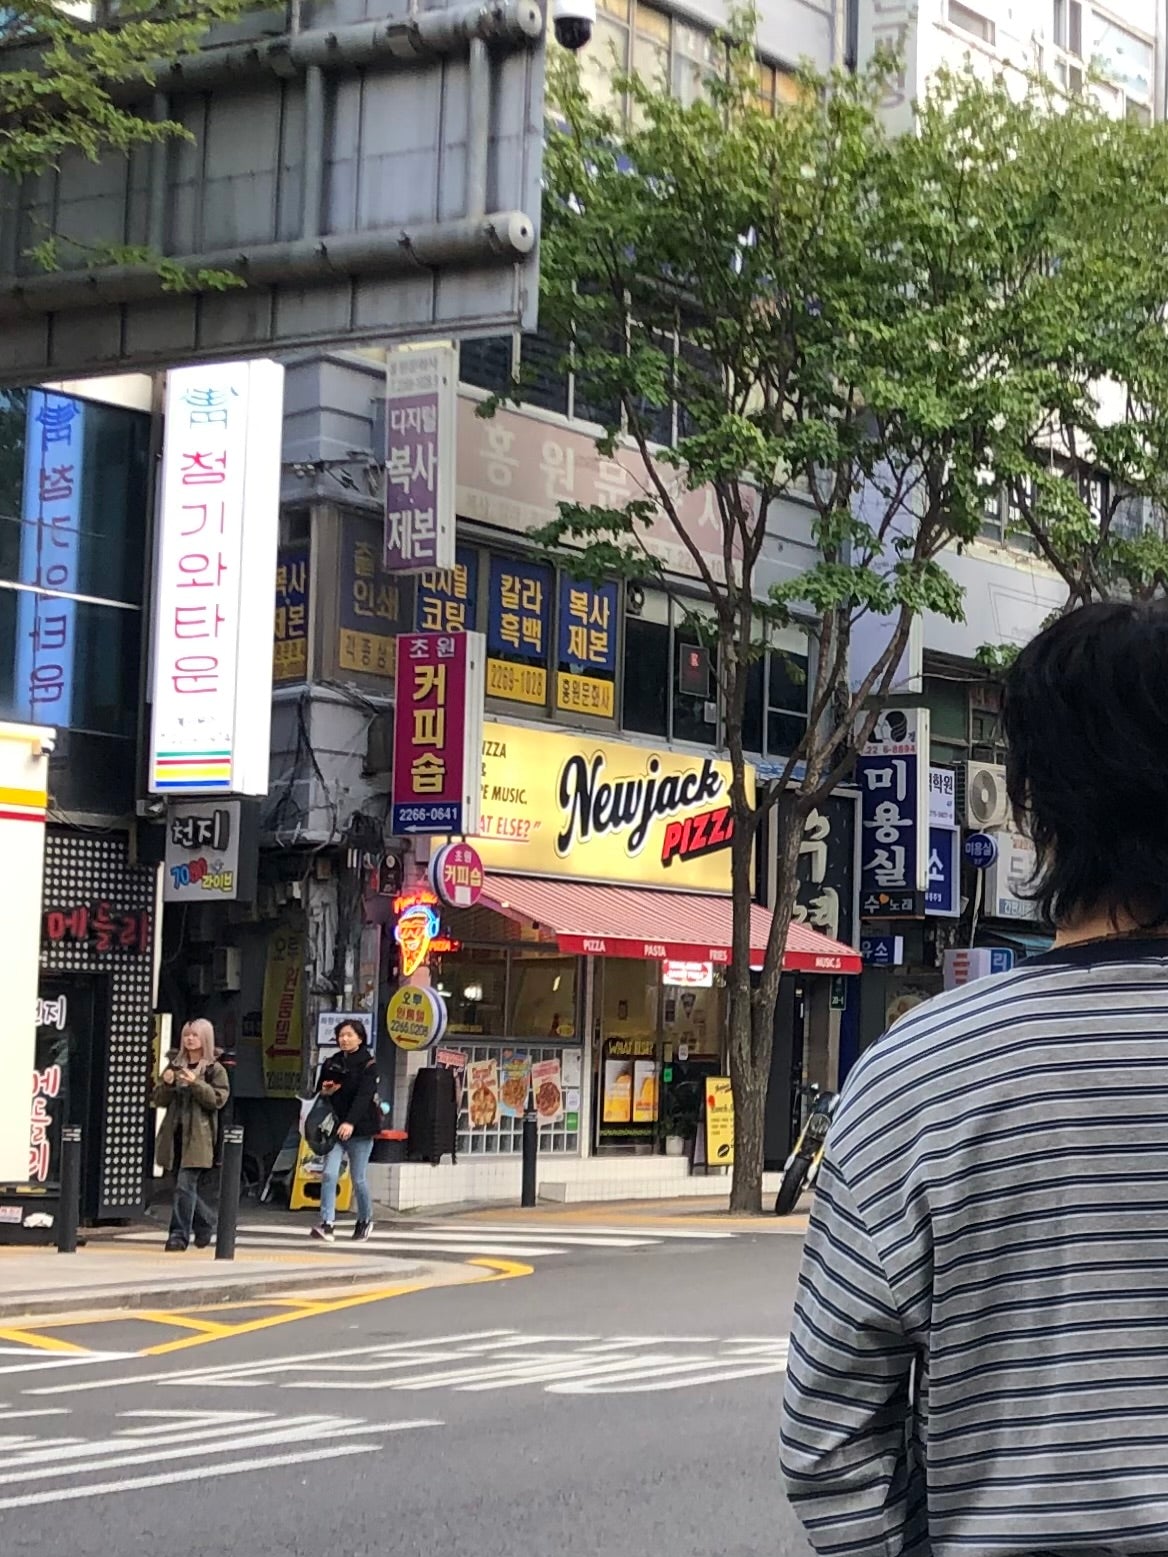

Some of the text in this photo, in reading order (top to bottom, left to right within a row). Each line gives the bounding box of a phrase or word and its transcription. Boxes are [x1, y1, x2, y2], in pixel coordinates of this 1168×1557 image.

[391, 404, 437, 436] 디지털
[390, 442, 437, 493] 복사
[387, 508, 436, 560] 제본
[501, 574, 543, 615] 칼라
[570, 589, 609, 629] 복사
[422, 597, 465, 632] 코팅
[501, 613, 542, 653] 흑백
[568, 625, 609, 663] 제본
[410, 663, 446, 794] 커피숍
[481, 740, 507, 759] IZZA
[929, 773, 953, 795] 학원
[399, 807, 458, 822] 2266-0641
[557, 755, 723, 853] Newjack
[863, 759, 913, 887] 미용실
[172, 810, 224, 849] 천지
[965, 842, 992, 857] 미용실
[444, 864, 482, 887] 커피숍
[583, 939, 606, 953] PIZZA
[644, 944, 666, 957] PASTA
[709, 949, 728, 962] FRIES
